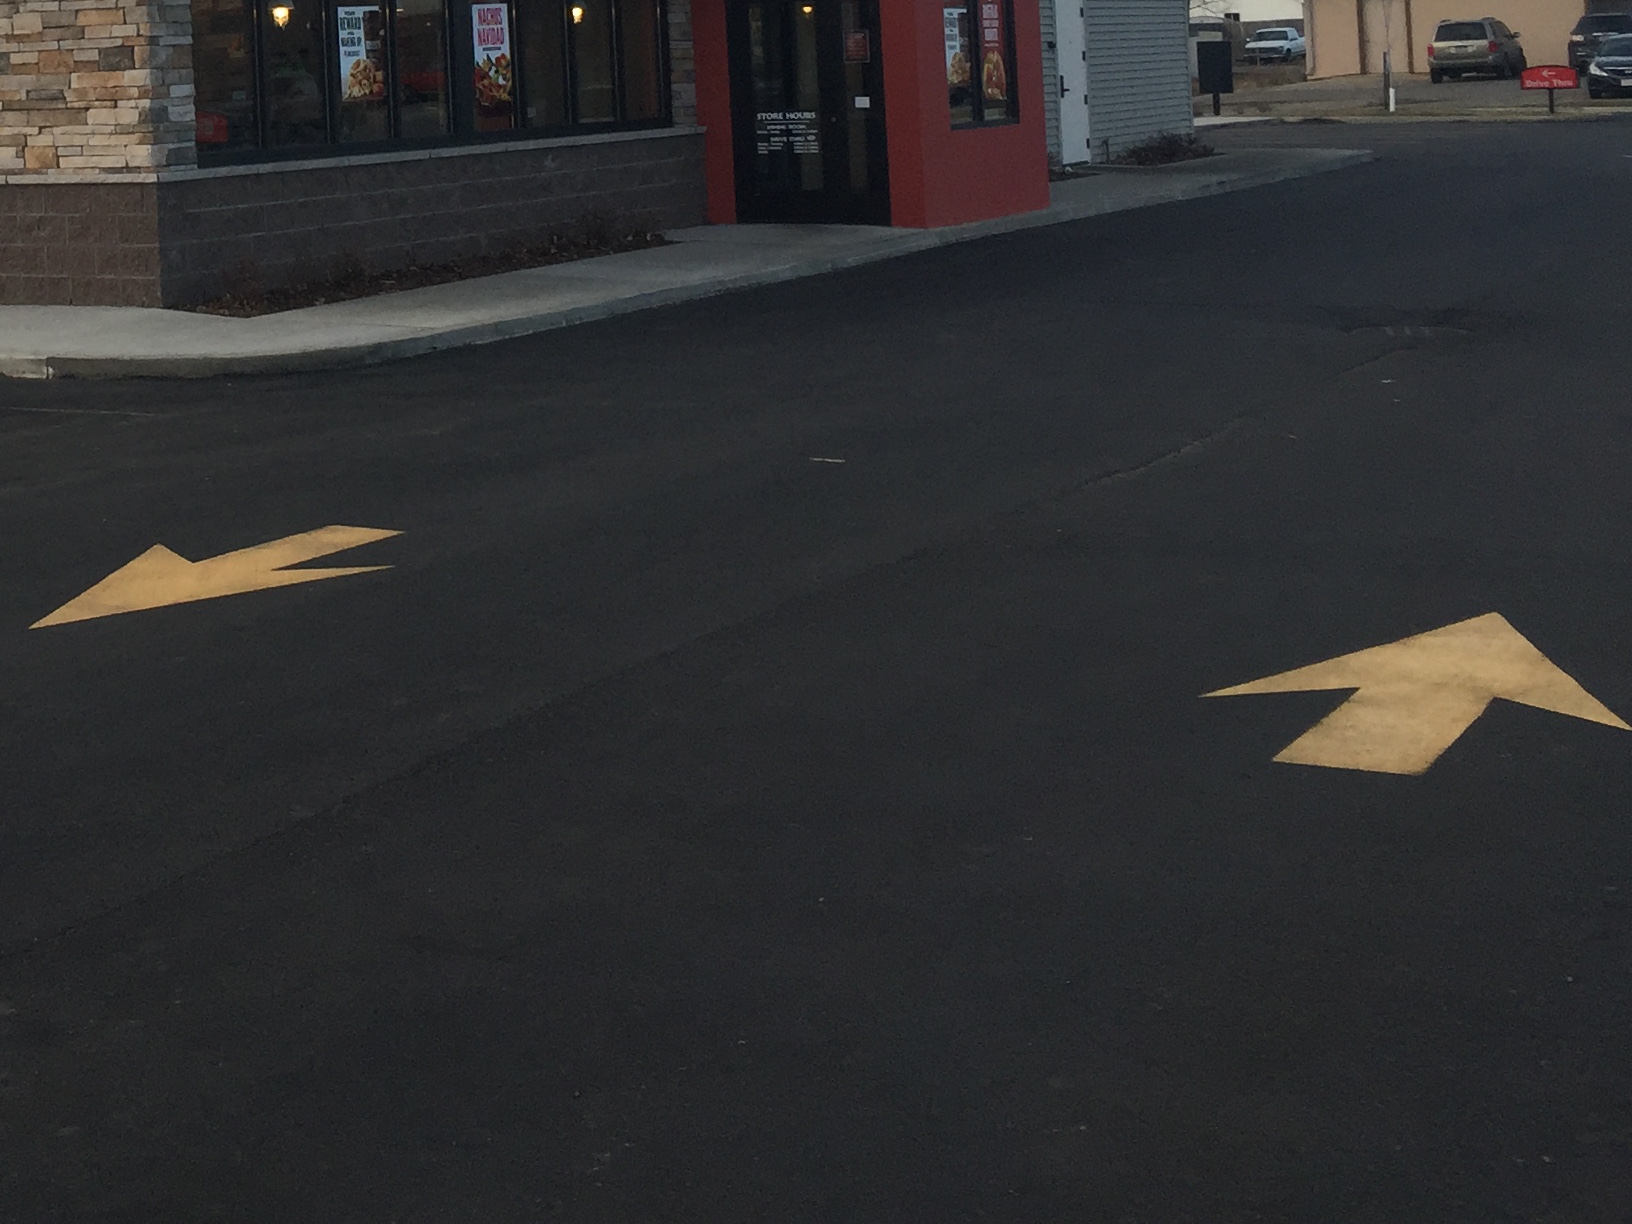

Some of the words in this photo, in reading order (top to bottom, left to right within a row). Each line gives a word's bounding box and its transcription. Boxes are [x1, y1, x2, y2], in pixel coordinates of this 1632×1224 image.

[477, 7, 503, 26] NACHOS
[477, 27, 505, 47] NAVIDAD
[1525, 79, 1550, 88] Drive
[1552, 78, 1574, 87] Thru
[756, 112, 784, 121] STORE
[785, 111, 817, 120] HOURS
